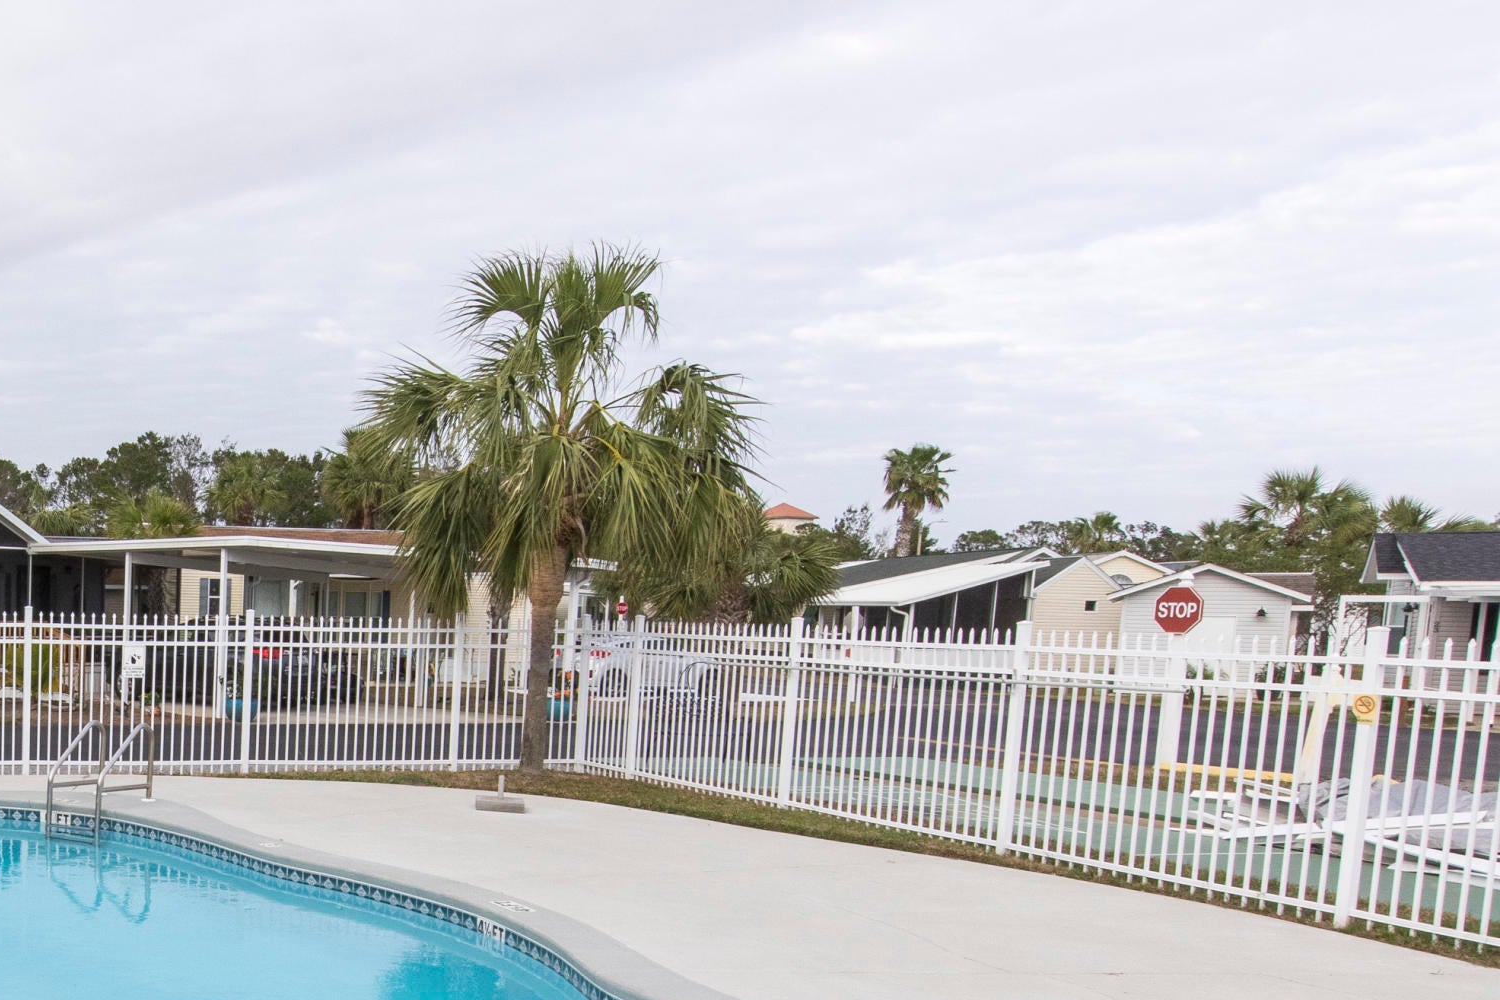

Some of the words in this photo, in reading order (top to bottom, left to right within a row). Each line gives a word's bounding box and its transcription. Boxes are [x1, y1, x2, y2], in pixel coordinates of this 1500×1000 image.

[1157, 601, 1198, 618] STOP
[56, 813, 69, 825] FT
[492, 924, 504, 941] FT
